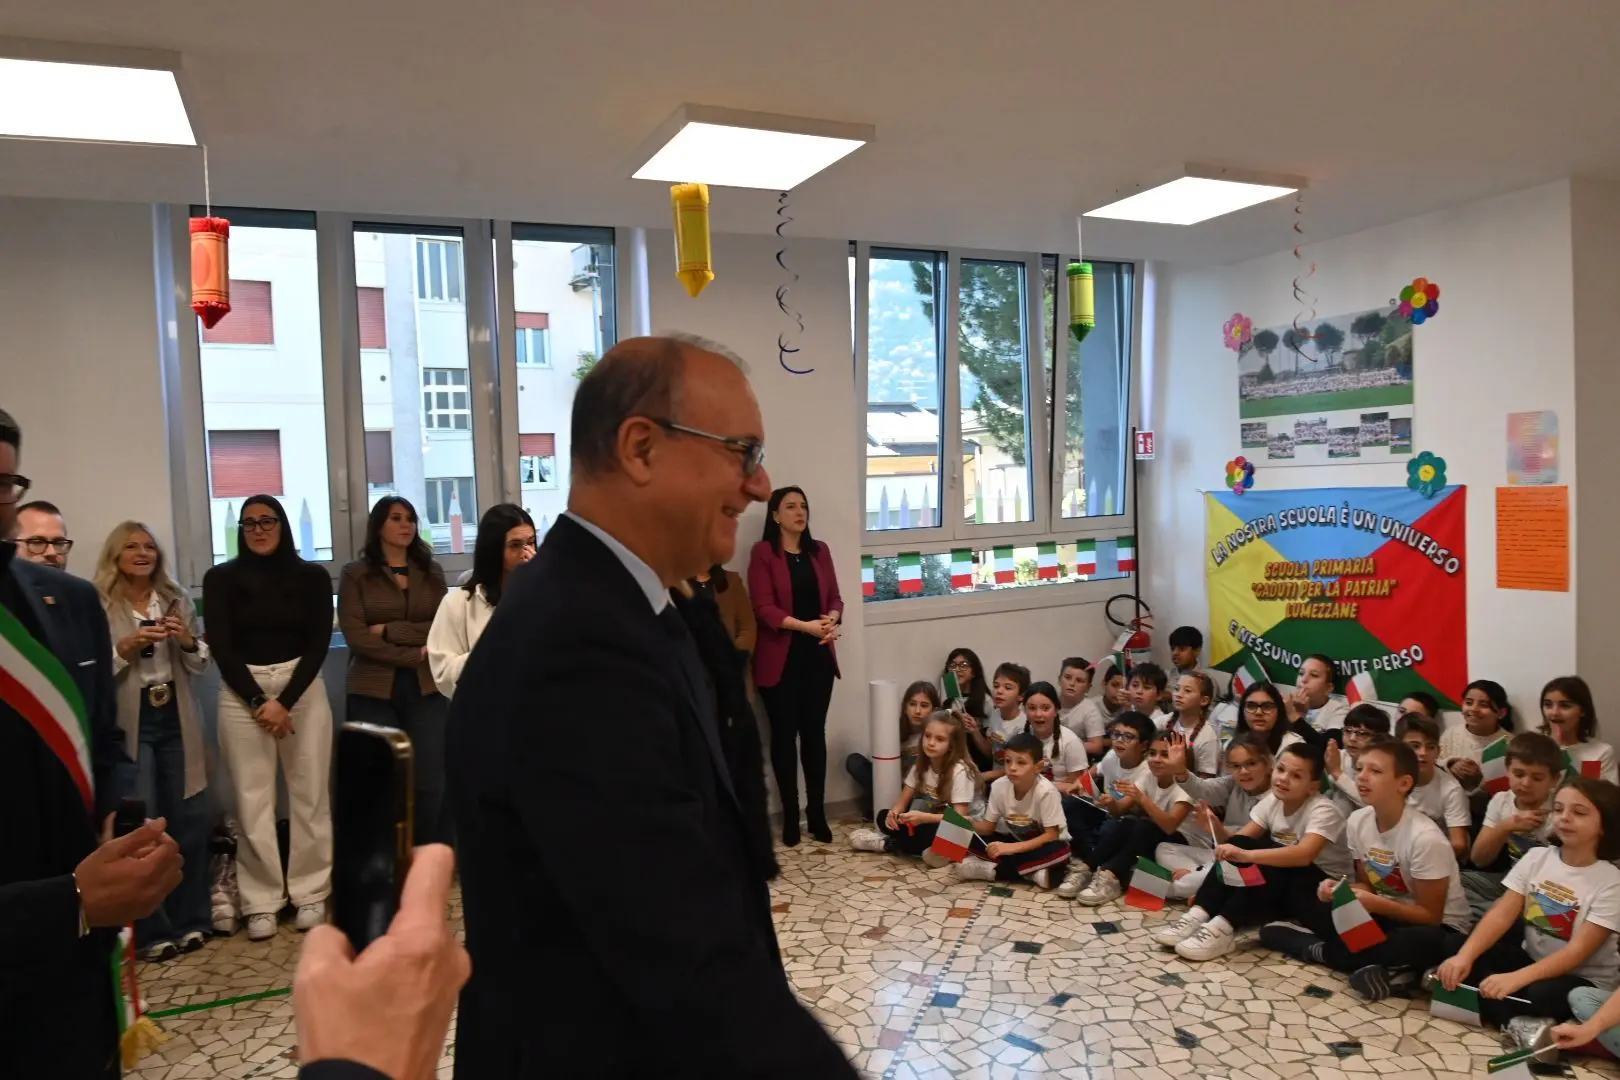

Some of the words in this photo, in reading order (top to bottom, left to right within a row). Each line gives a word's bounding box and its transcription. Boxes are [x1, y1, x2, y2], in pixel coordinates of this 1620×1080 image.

[1211, 541, 1229, 566] LA
[1225, 513, 1278, 553] NOSTRA
[1279, 505, 1338, 529] SCUOLA
[1341, 501, 1350, 525] È
[1352, 508, 1377, 531] UN
[1380, 516, 1461, 575] UNIVERSO
[1264, 560, 1310, 579] SCUOLA
[1312, 557, 1376, 578] PRIMARIA
[1299, 580, 1323, 599] PER
[1324, 580, 1341, 597] LA
[1343, 579, 1397, 597] PATRIA"
[1285, 602, 1359, 619] LUMEZZANE
[1230, 619, 1239, 636] E
[1239, 626, 1302, 669] NESSUNO
[1373, 644, 1424, 671] PERSO
